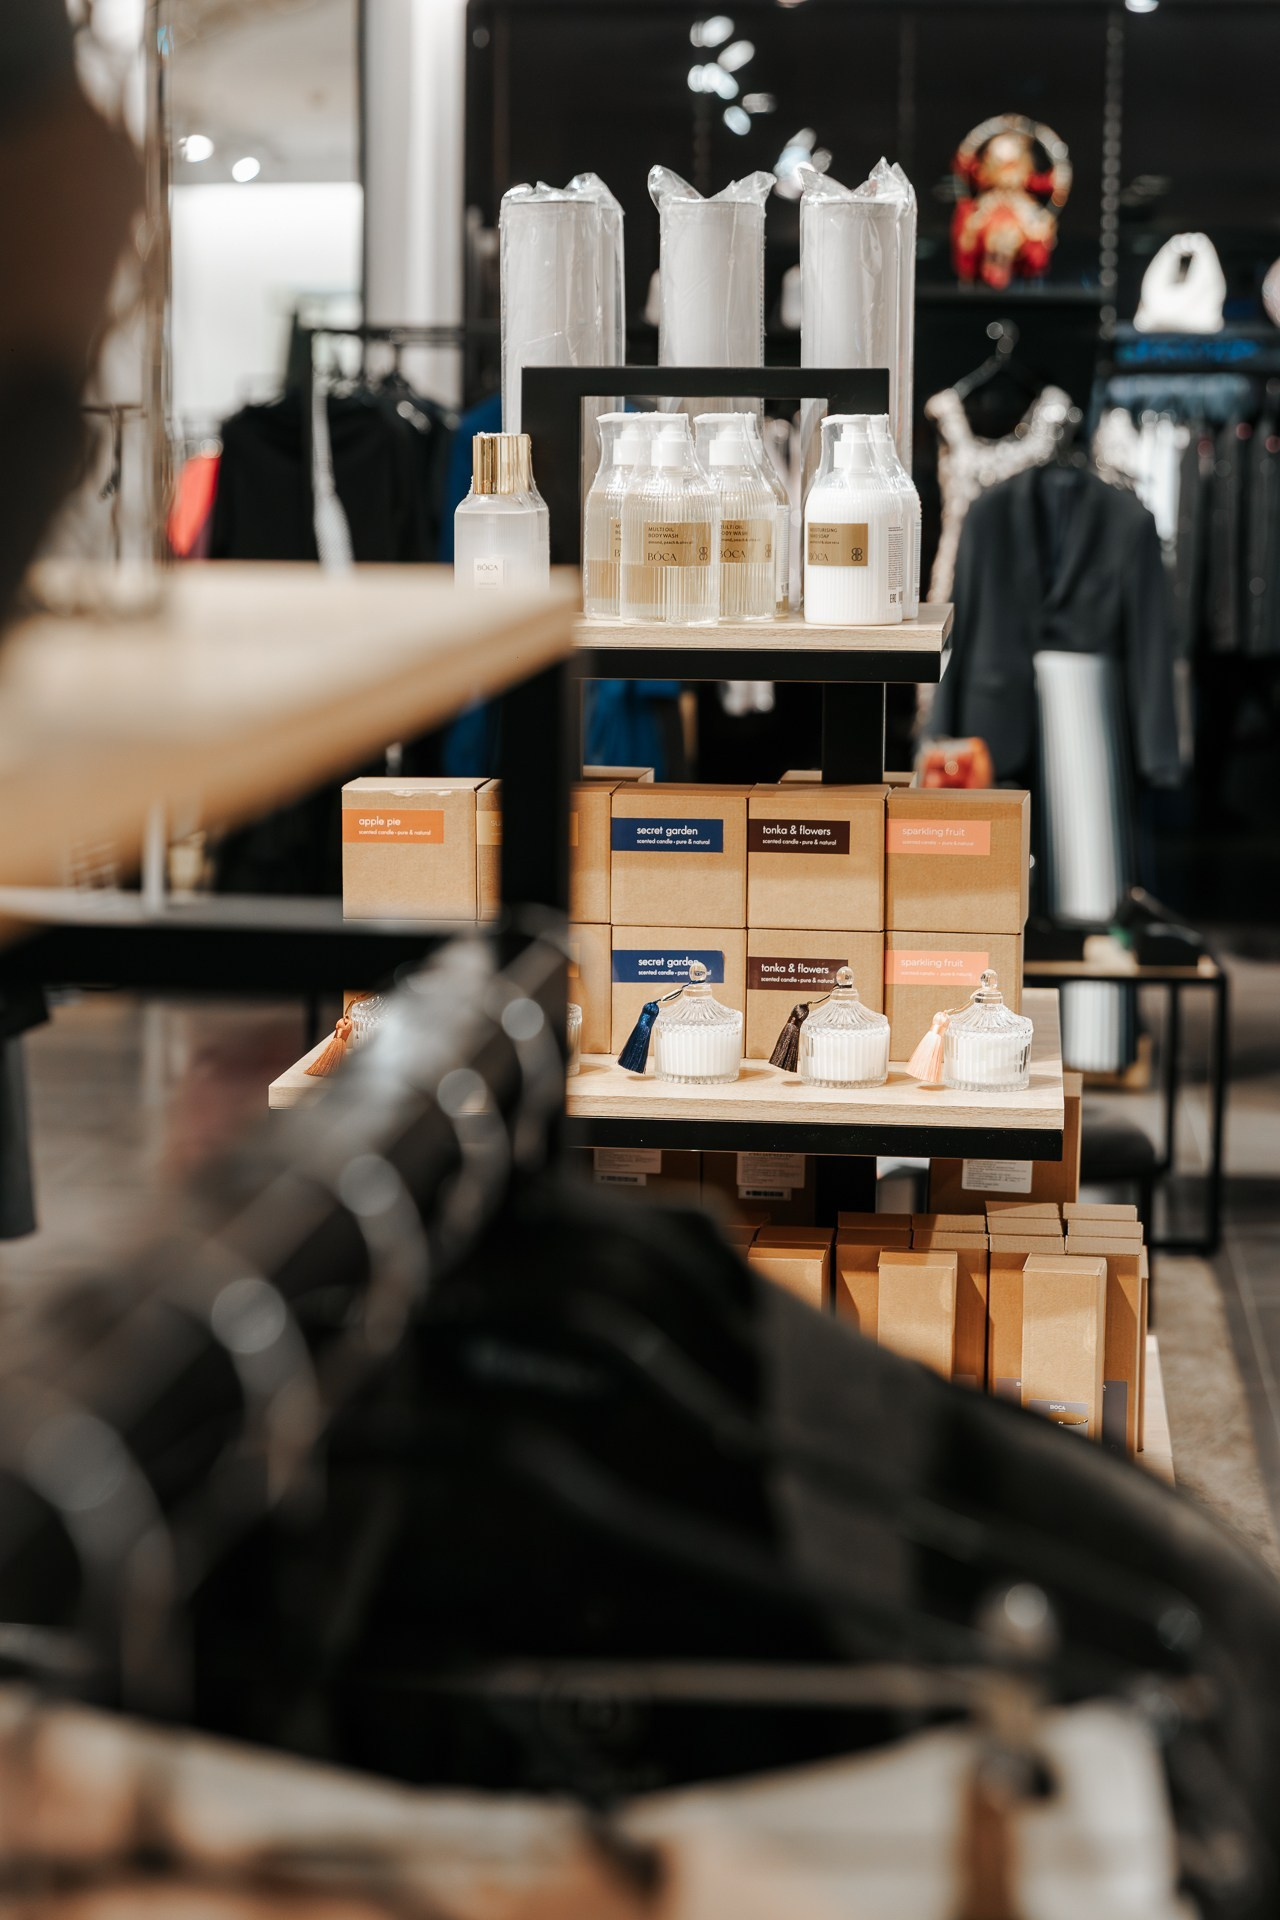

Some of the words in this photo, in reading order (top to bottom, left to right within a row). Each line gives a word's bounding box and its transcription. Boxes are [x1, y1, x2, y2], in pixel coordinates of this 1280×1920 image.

[358, 816, 384, 827] apple
[387, 817, 401, 828] pie
[636, 826, 663, 835] secret
[665, 825, 698, 837] garden
[762, 825, 788, 835] tonka
[790, 825, 797, 835] &
[799, 825, 831, 836] flowers
[902, 827, 944, 837] sparkling
[945, 827, 965, 836] fruit
[638, 957, 664, 966] secret
[901, 958, 942, 968] sparkling
[944, 958, 964, 967] fruit
[761, 963, 786, 973] tonka
[788, 963, 795, 973] &
[797, 963, 829, 974] flowers
